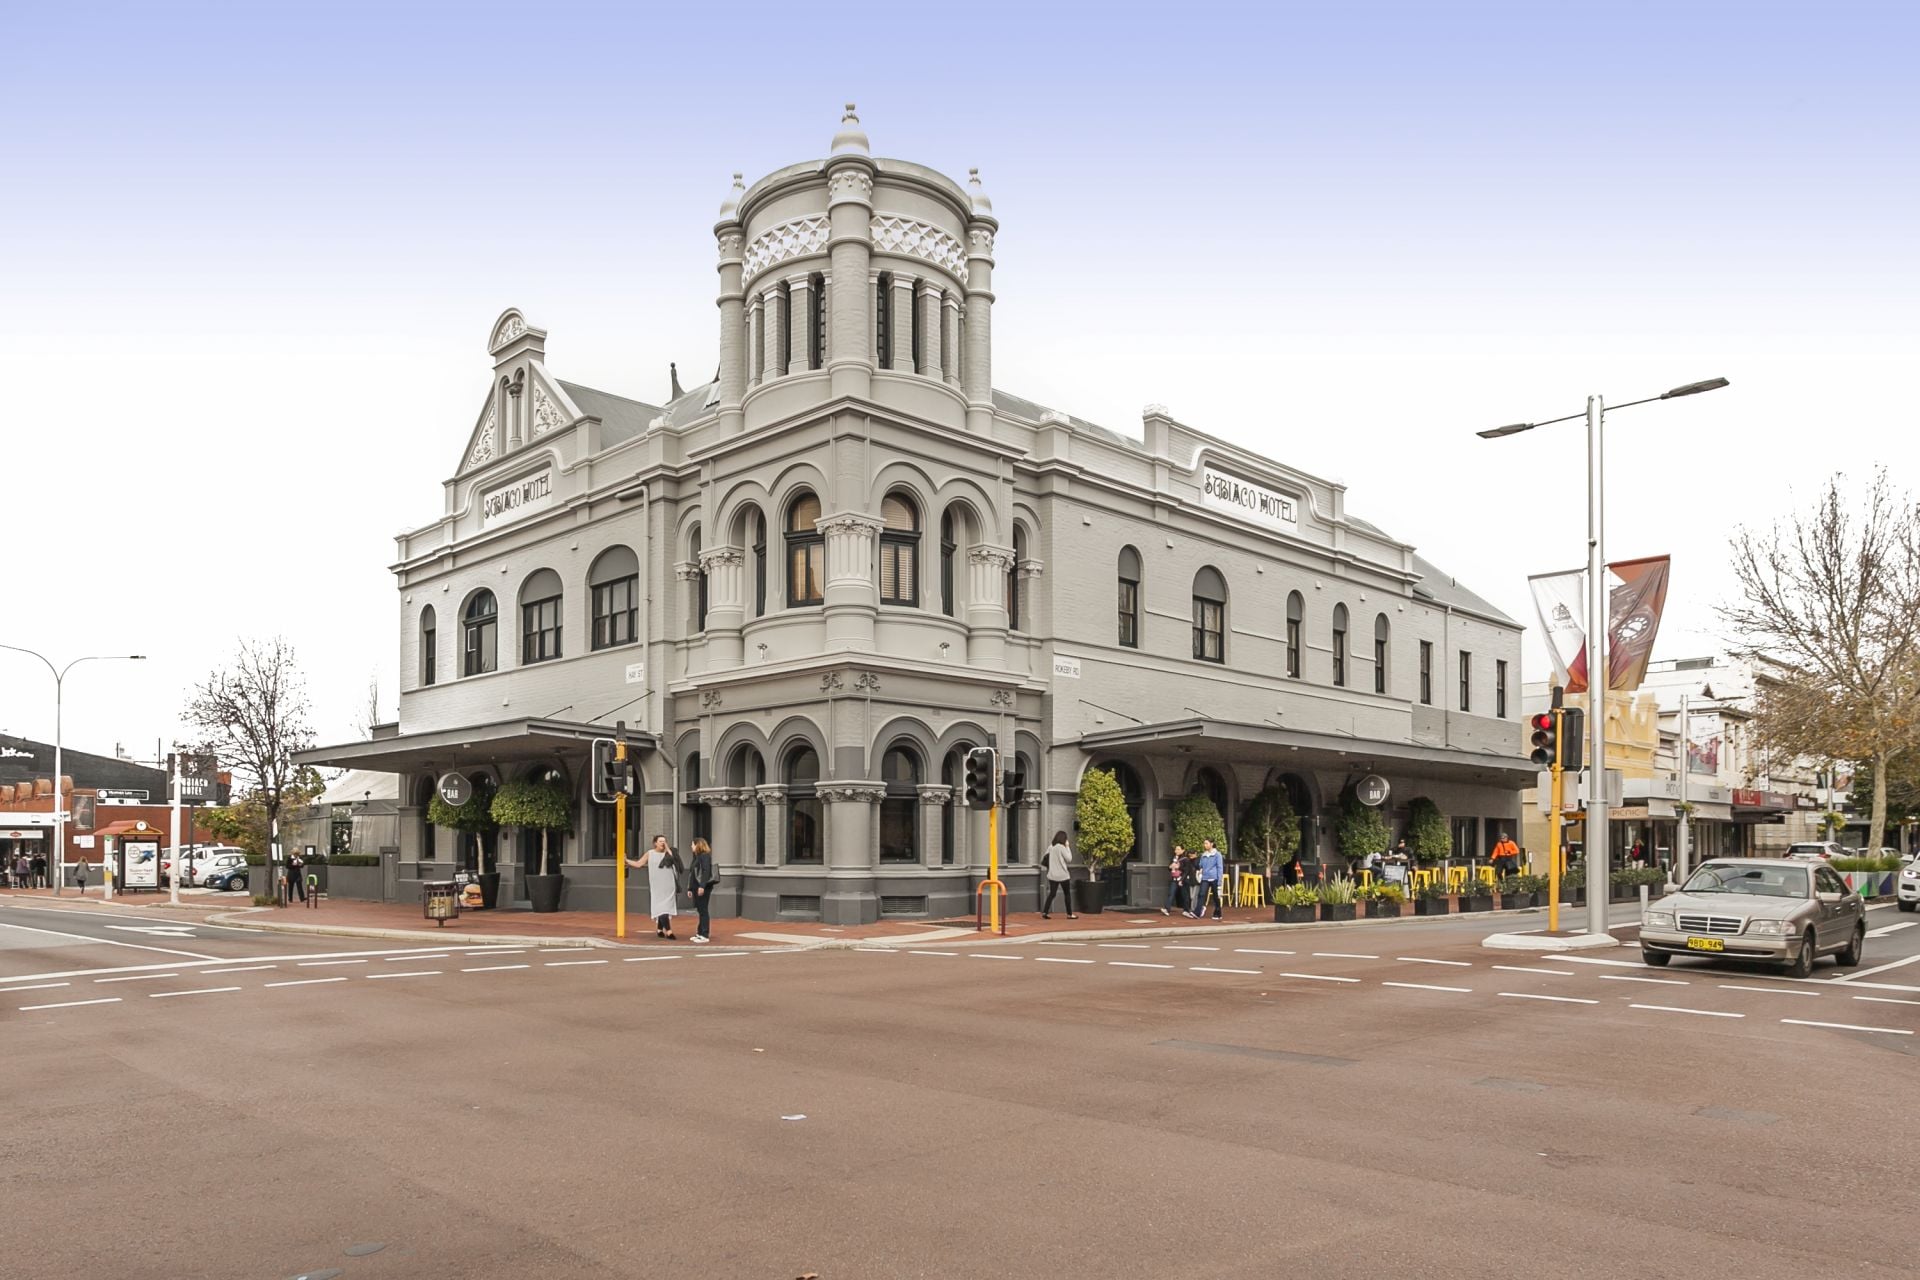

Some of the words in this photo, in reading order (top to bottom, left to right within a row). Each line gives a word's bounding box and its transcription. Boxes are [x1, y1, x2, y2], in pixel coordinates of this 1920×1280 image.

[485, 488, 520, 519] SUBIACO
[522, 472, 552, 504] HOTEL
[1204, 474, 1256, 510] SUBIACO
[1258, 491, 1297, 524] HOTEL
[182, 786, 203, 796] HOTEL
[447, 789, 458, 799] BAR
[1369, 790, 1381, 799] BAR
